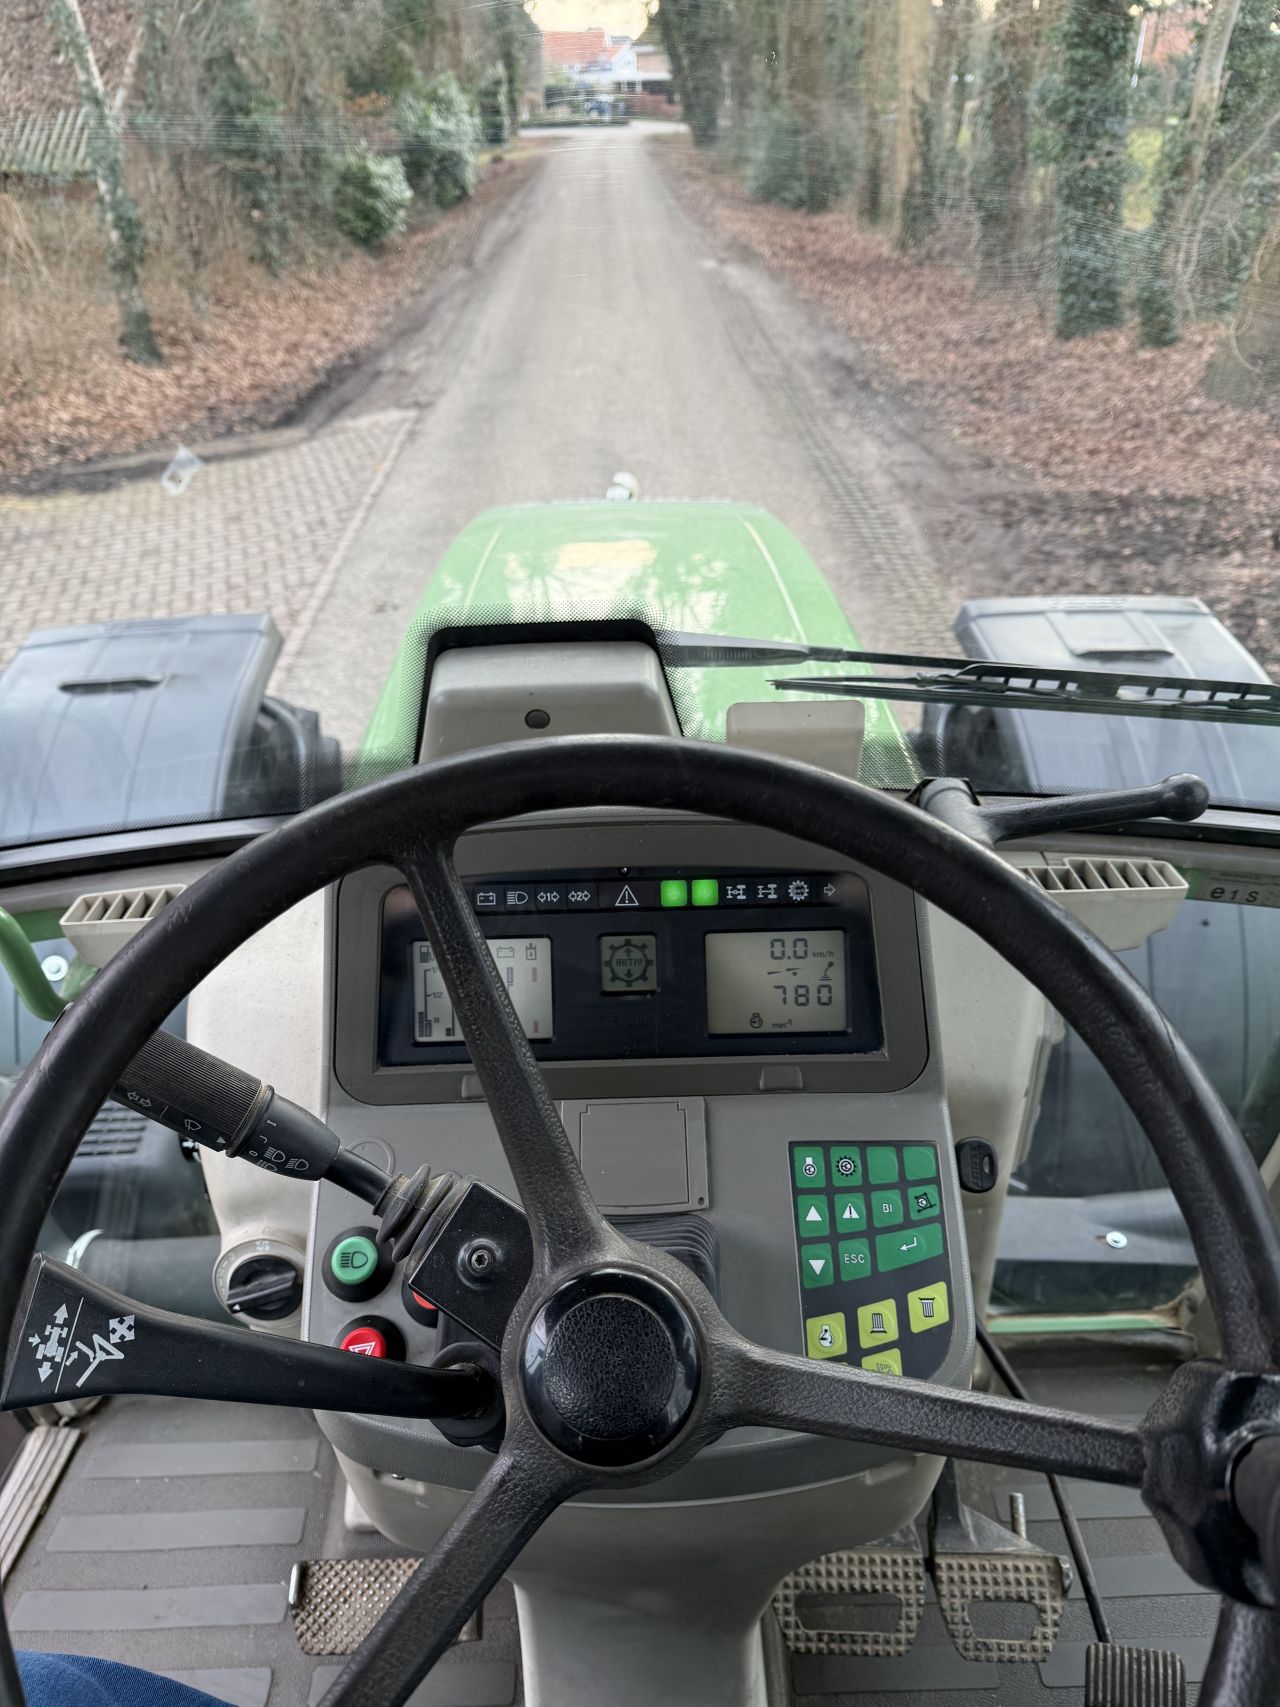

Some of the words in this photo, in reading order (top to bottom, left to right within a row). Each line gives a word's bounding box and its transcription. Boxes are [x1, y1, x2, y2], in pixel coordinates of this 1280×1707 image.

[770, 938, 808, 960] 0.0
[812, 950, 835, 959] km/h
[773, 985, 832, 1006] 780
[844, 1253, 865, 1264] ESC
